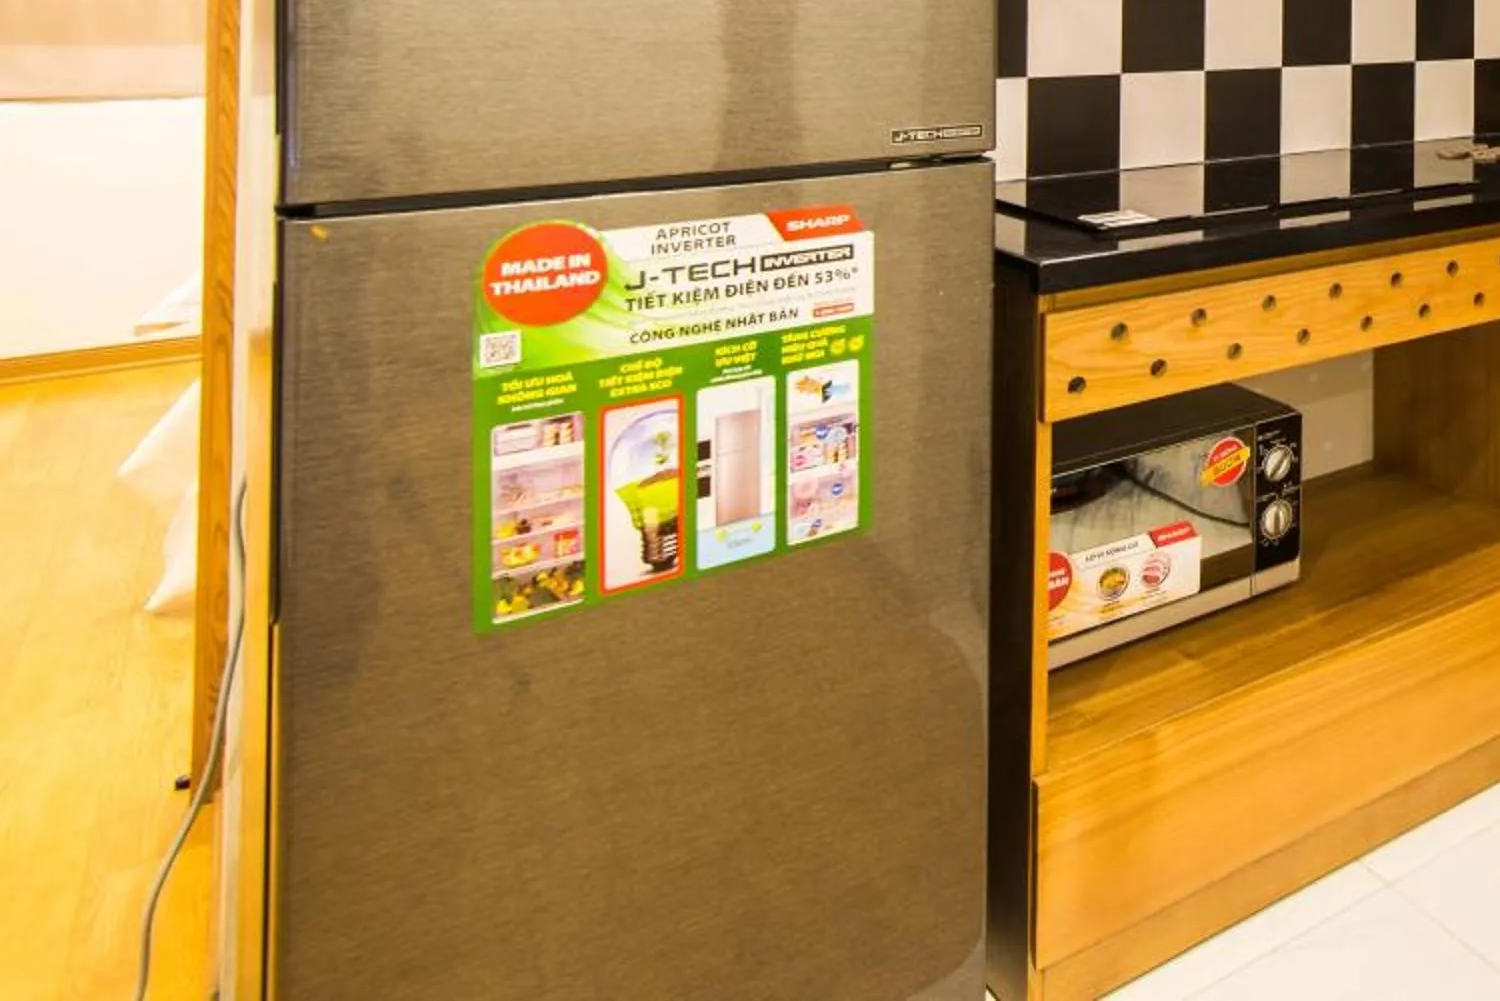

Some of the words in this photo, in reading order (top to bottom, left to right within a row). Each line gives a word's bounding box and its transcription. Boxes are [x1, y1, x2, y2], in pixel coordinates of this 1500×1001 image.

[655, 221, 732, 241] APRICOT
[785, 214, 851, 232] SHARP
[650, 235, 737, 256] INVERTER
[501, 256, 565, 276] MADE
[567, 253, 591, 268] IN
[624, 256, 756, 292] J-TECH
[763, 245, 852, 270] INVERTER
[489, 270, 601, 295] THAILAND
[626, 289, 667, 312] TIẾT
